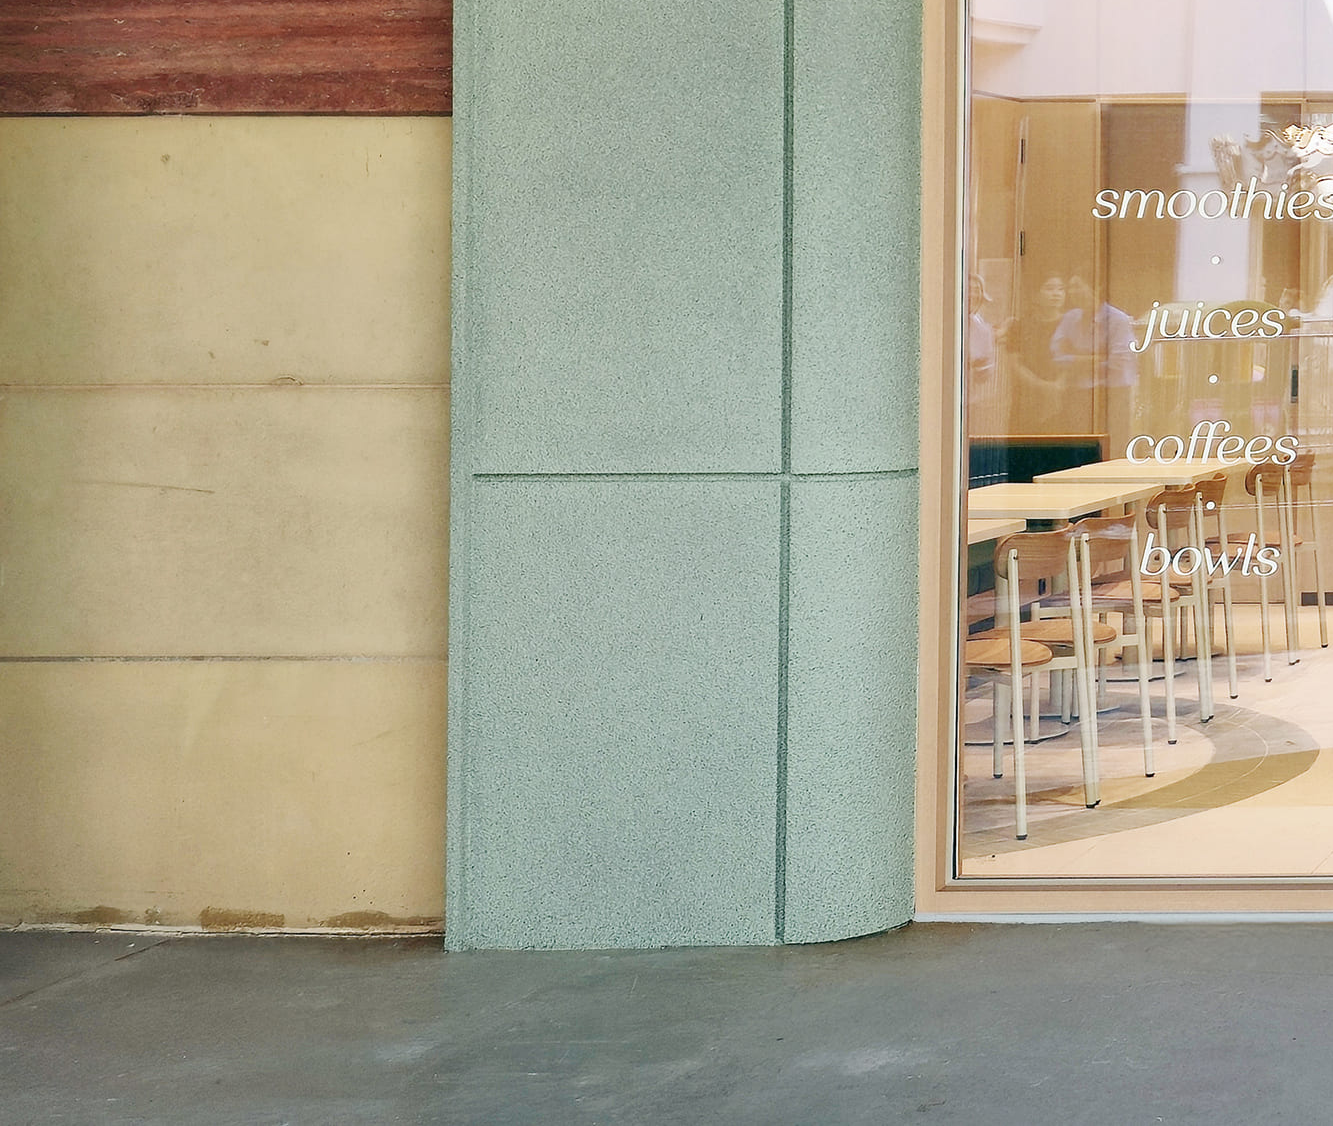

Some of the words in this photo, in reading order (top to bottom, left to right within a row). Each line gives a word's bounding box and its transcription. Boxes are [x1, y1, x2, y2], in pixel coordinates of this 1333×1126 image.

[1129, 301, 1286, 353] juices
[1125, 420, 1300, 466] coffees
[1139, 532, 1281, 578] bowls
